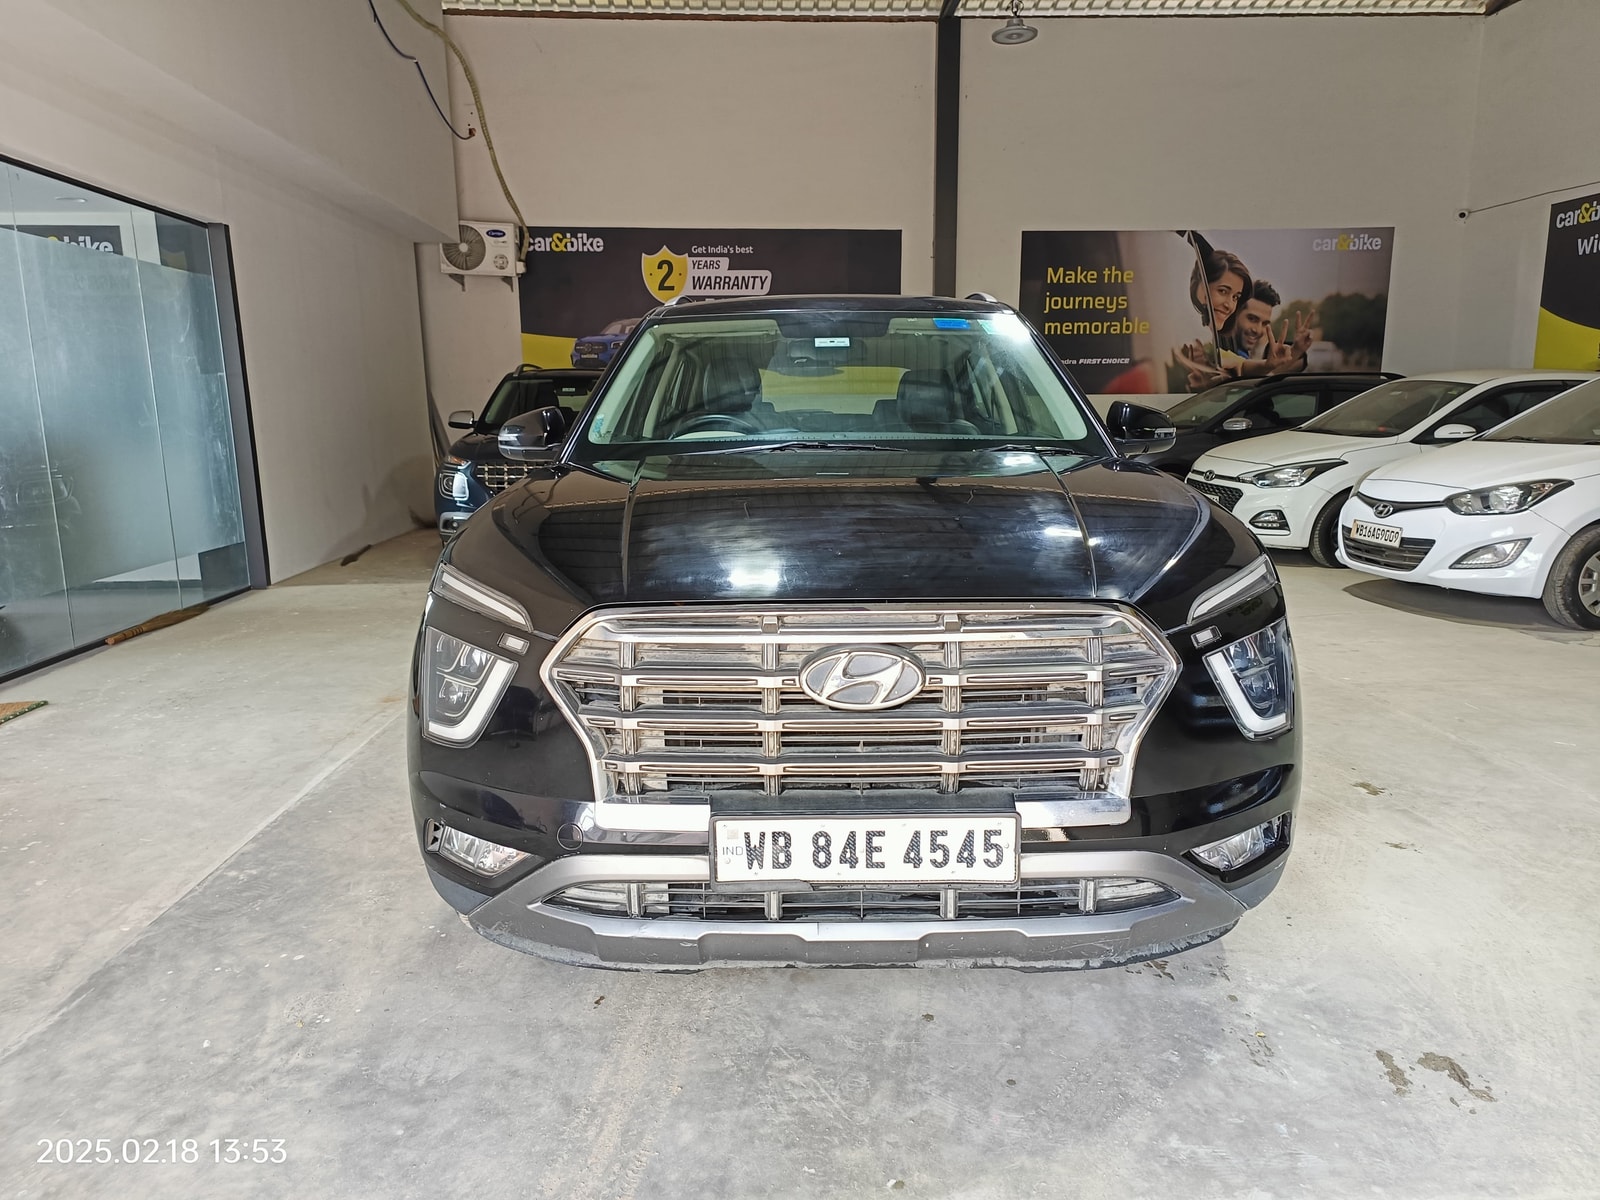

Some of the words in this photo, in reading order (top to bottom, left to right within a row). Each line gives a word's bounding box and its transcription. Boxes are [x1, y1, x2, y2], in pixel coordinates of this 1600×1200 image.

[528, 232, 604, 252] car&bike
[691, 245, 707, 254] Get
[708, 245, 734, 254] India's
[735, 245, 754, 254] best
[1313, 233, 1382, 252] car&bike
[1577, 233, 1600, 256] Wi
[691, 259, 721, 270] YEARS
[656, 259, 676, 291] 2
[692, 275, 768, 290] WARRANTY
[1046, 266, 1098, 284] Make
[1102, 266, 1135, 284] the
[1043, 291, 1129, 314] journeys
[1044, 316, 1150, 335] memorable
[722, 845, 744, 856] IND
[743, 829, 793, 870] WB
[811, 829, 886, 870] 84E
[903, 829, 1004, 869] 4545
